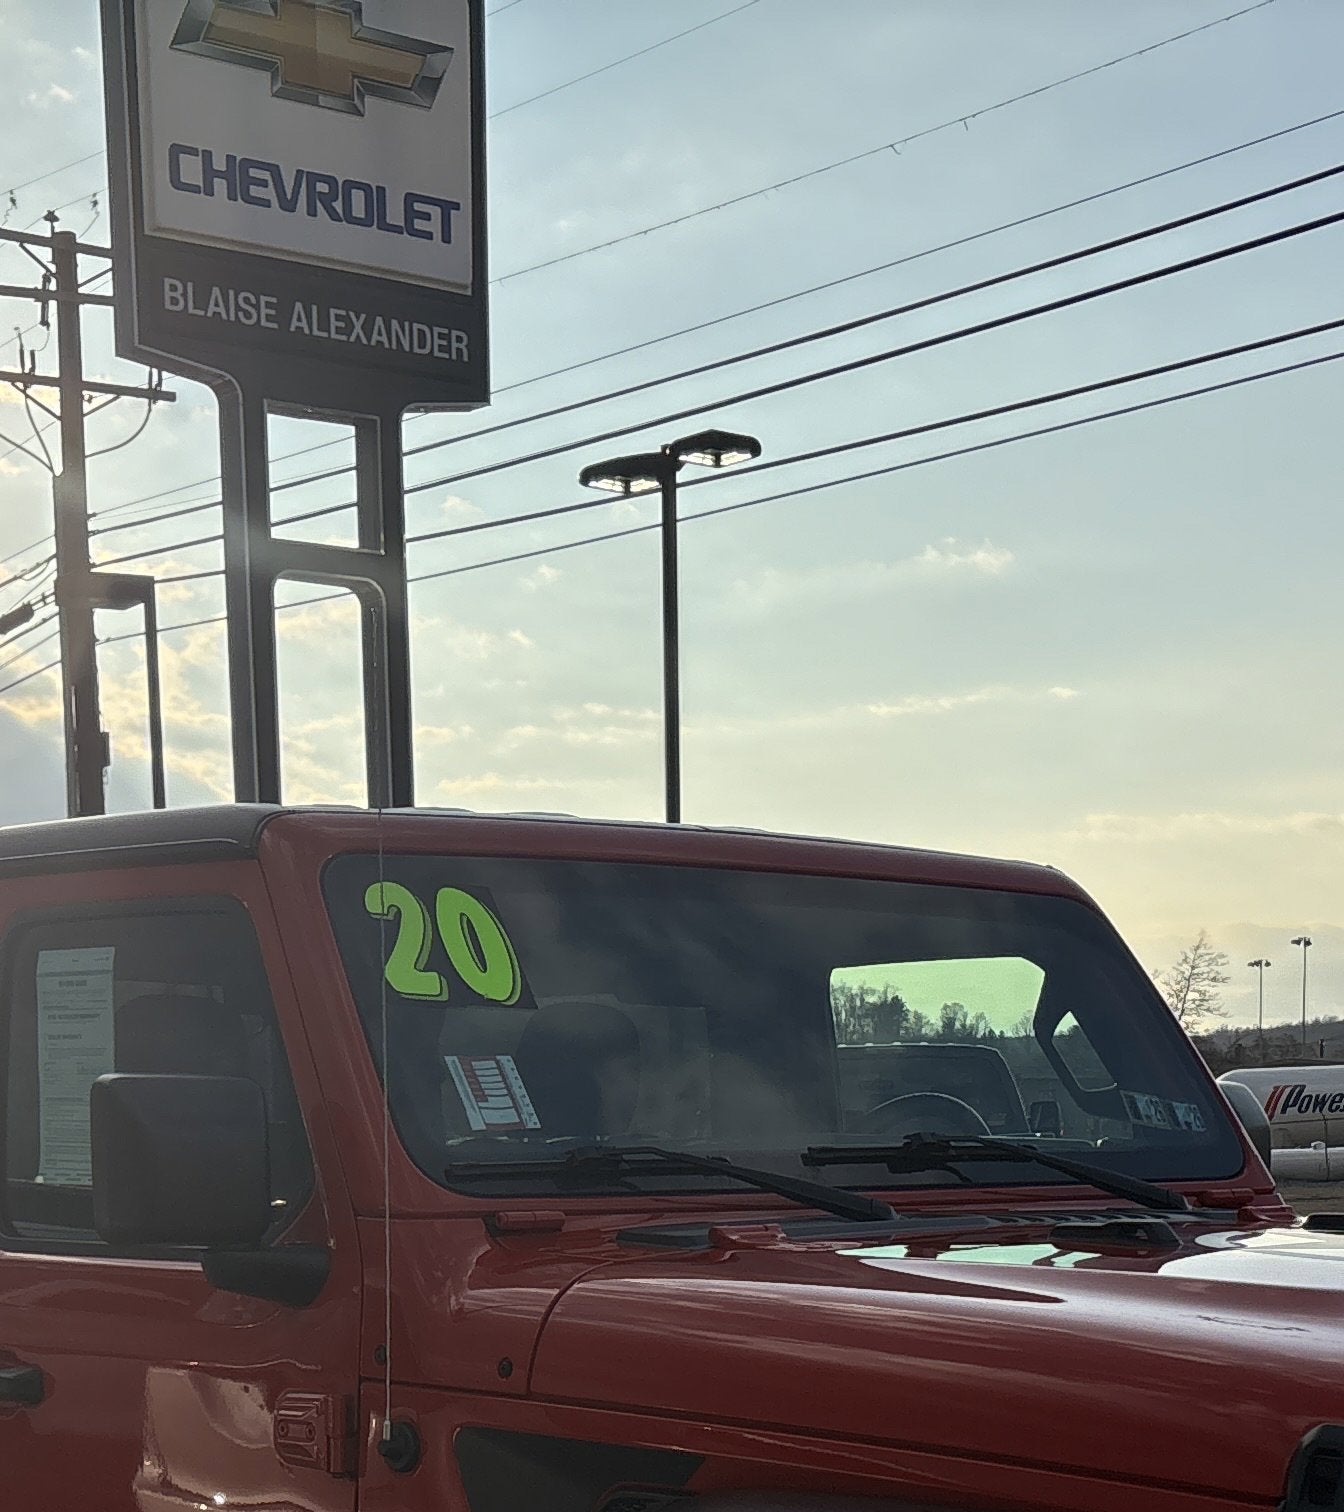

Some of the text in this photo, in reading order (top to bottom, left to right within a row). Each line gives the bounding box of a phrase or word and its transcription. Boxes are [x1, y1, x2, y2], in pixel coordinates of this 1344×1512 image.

[167, 142, 461, 245] CHEVROLET
[162, 277, 470, 363] BLAISE ALEXANDER
[363, 881, 522, 1007] 20
